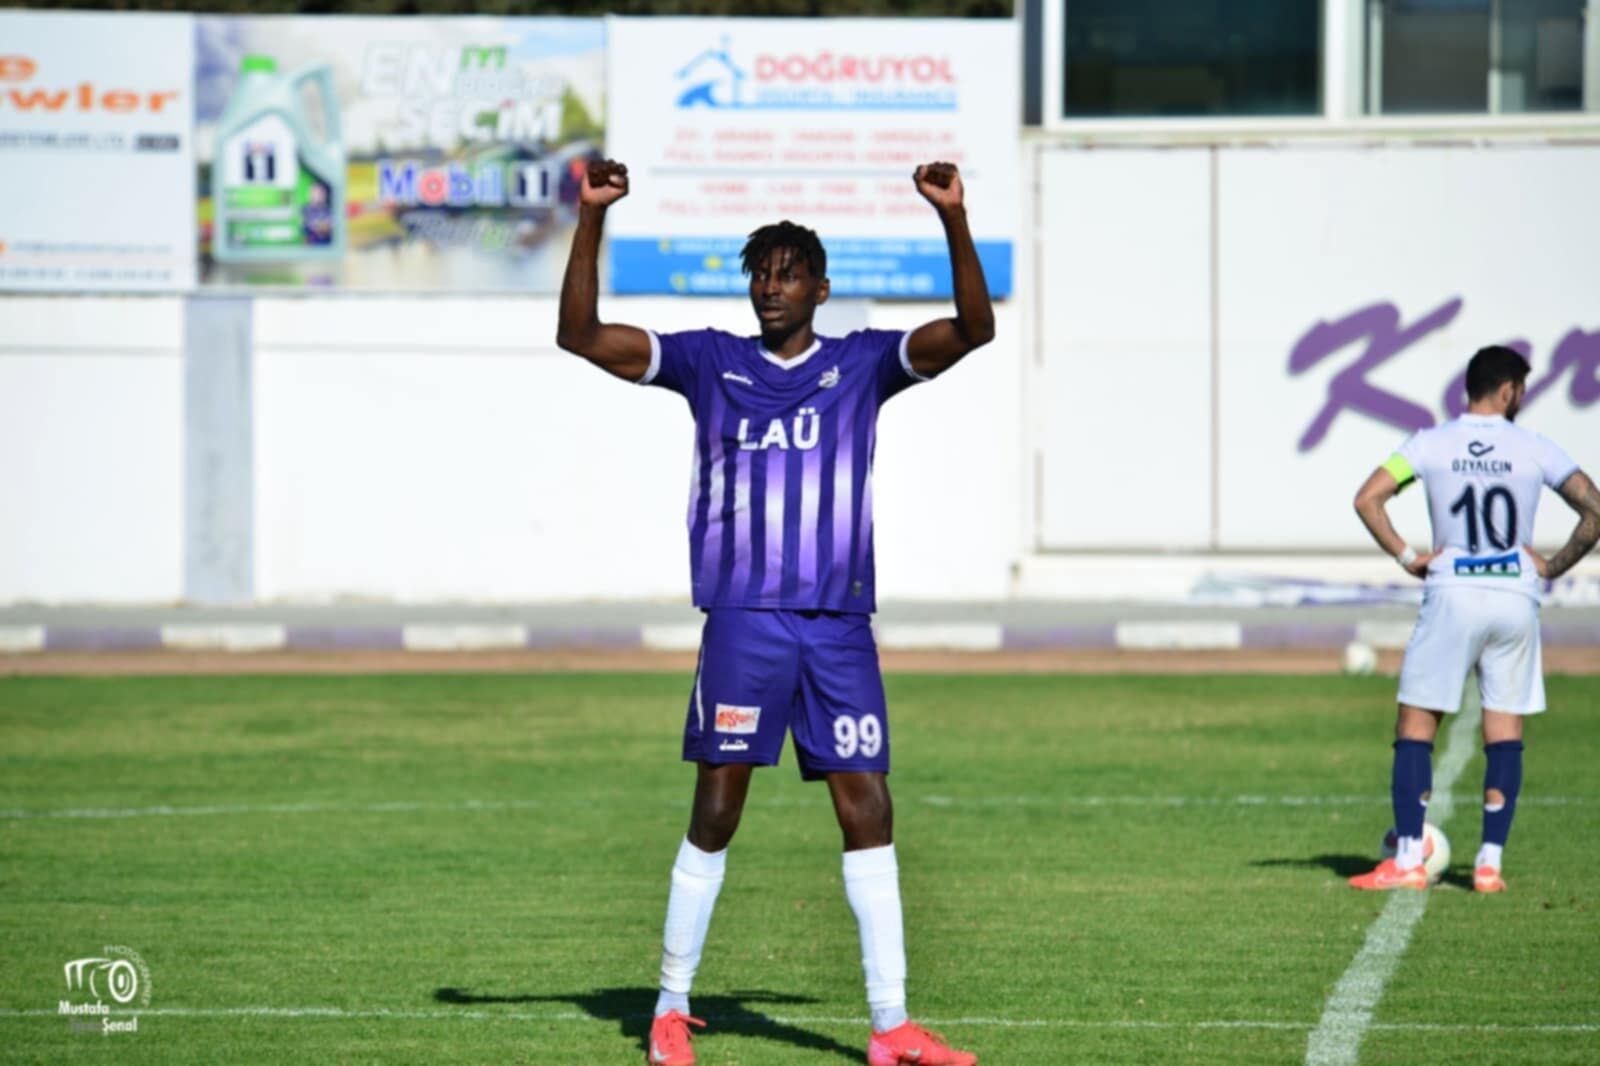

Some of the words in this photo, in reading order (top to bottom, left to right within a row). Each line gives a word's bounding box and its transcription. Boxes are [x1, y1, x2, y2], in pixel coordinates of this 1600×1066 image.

[737, 407, 821, 451] LAÜ
[1451, 484, 1518, 552] 10
[834, 714, 882, 758] 99
